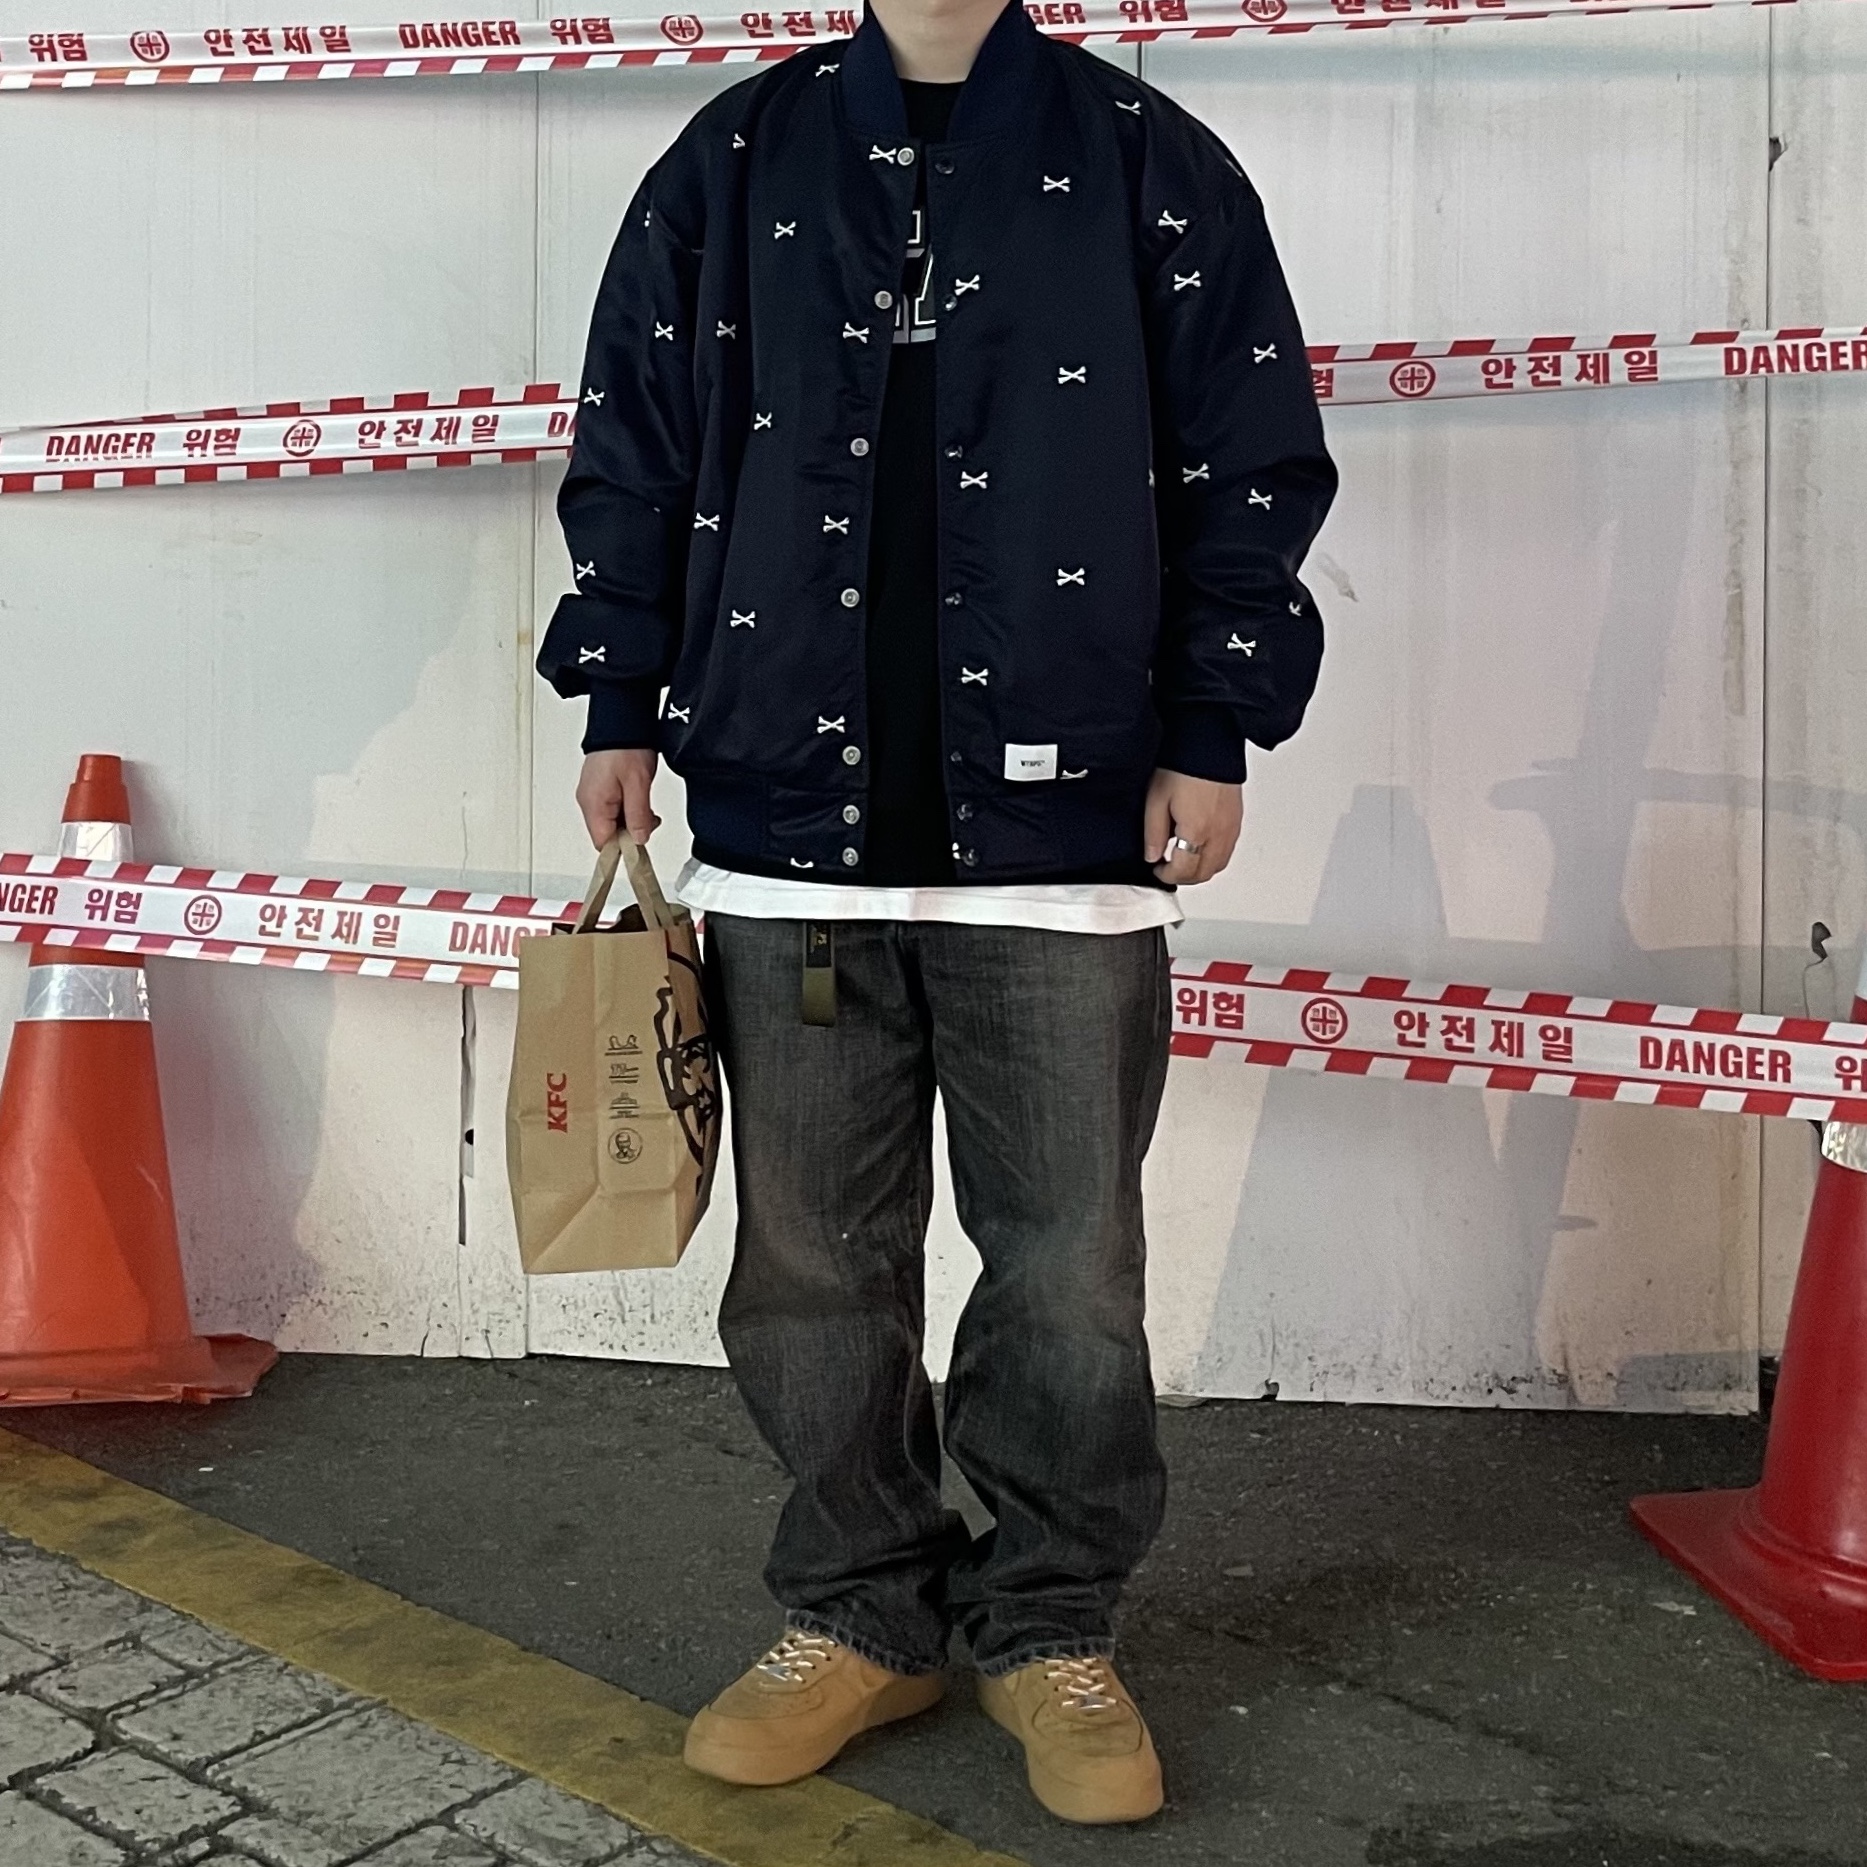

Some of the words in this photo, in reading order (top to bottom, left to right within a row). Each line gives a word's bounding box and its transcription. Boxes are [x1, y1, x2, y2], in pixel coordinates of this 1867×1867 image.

[28, 33, 88, 62] 위험
[399, 21, 521, 49] DANGER
[550, 18, 614, 45] 위험
[741, 10, 857, 38] 안전제
[1024, 3, 1086, 25] GER
[1119, 0, 1188, 23] 위험
[1312, 368, 1334, 398] 험
[1724, 340, 1867, 375] DANGER
[46, 432, 156, 462] DANGER
[183, 428, 240, 457] 위험
[0, 883, 58, 915] NGER
[85, 888, 143, 924] 위험
[449, 921, 548, 958] DANG
[1176, 987, 1245, 1030] 위험
[1640, 1036, 1791, 1083] DANGER
[1835, 1056, 1867, 1092] 위
[547, 1073, 567, 1133] KFC
